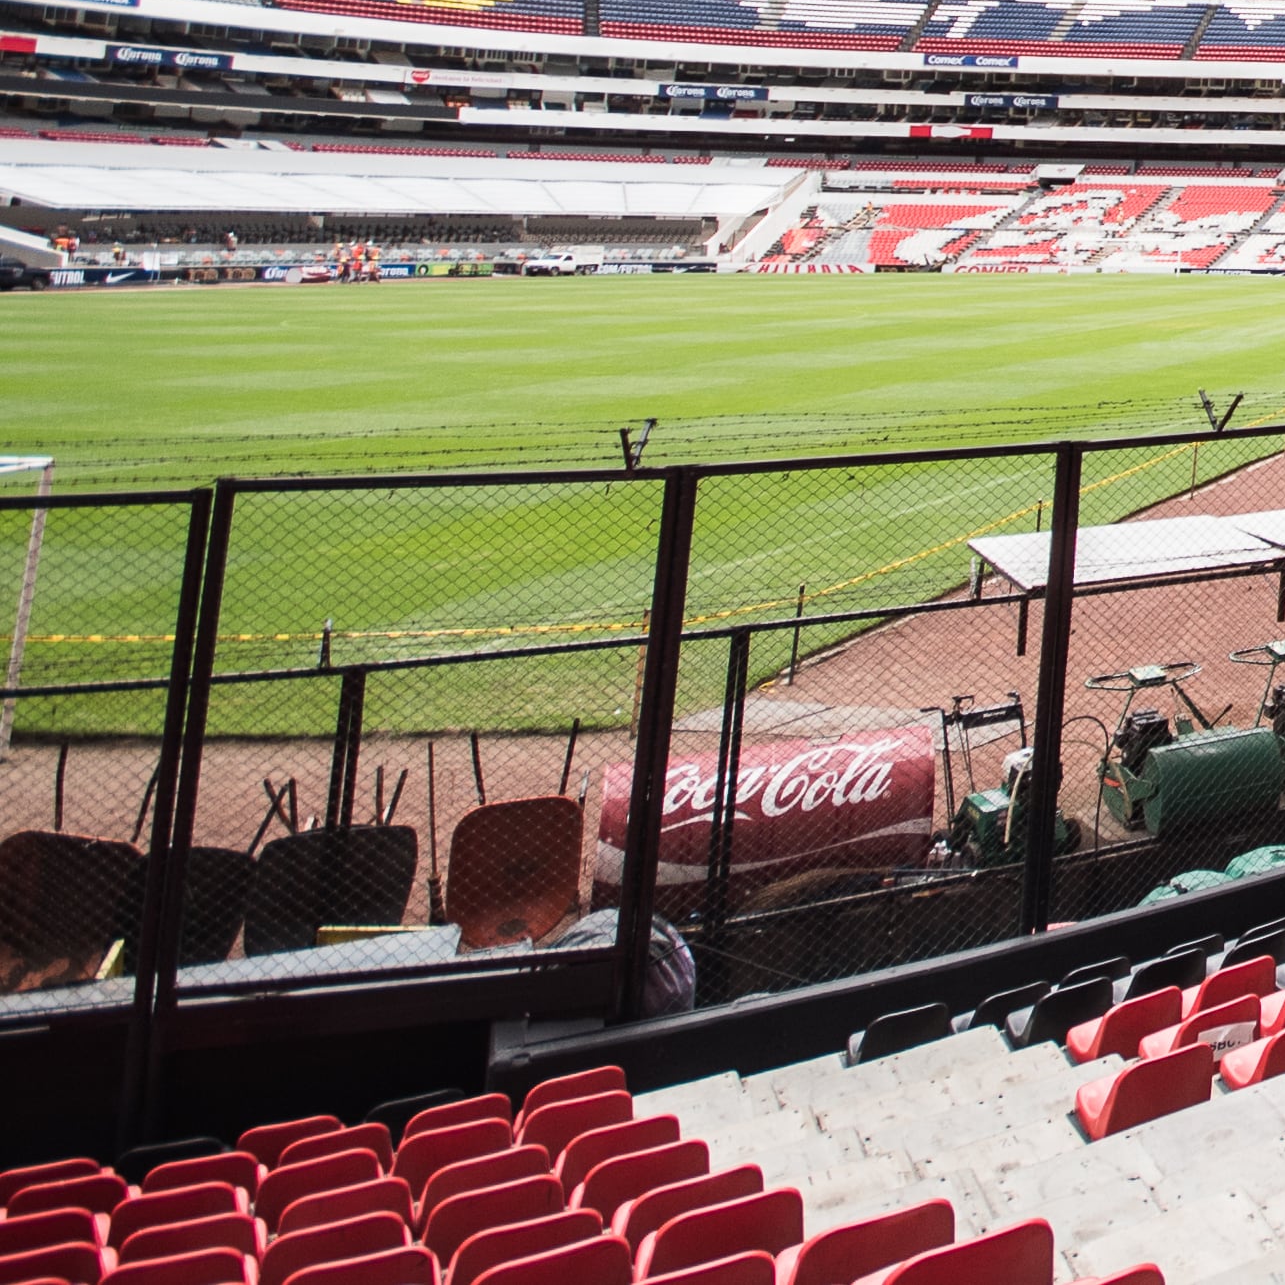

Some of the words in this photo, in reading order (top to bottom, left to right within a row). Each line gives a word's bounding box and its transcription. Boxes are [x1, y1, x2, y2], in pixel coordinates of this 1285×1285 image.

[118, 47, 162, 61] Corona
[175, 53, 218, 66] Corona
[928, 56, 966, 65] Comex
[976, 56, 1014, 66] Comex
[666, 85, 705, 97] Corona
[716, 86, 755, 98] Corona
[971, 96, 1003, 106] Corona
[1013, 97, 1046, 106] Corona
